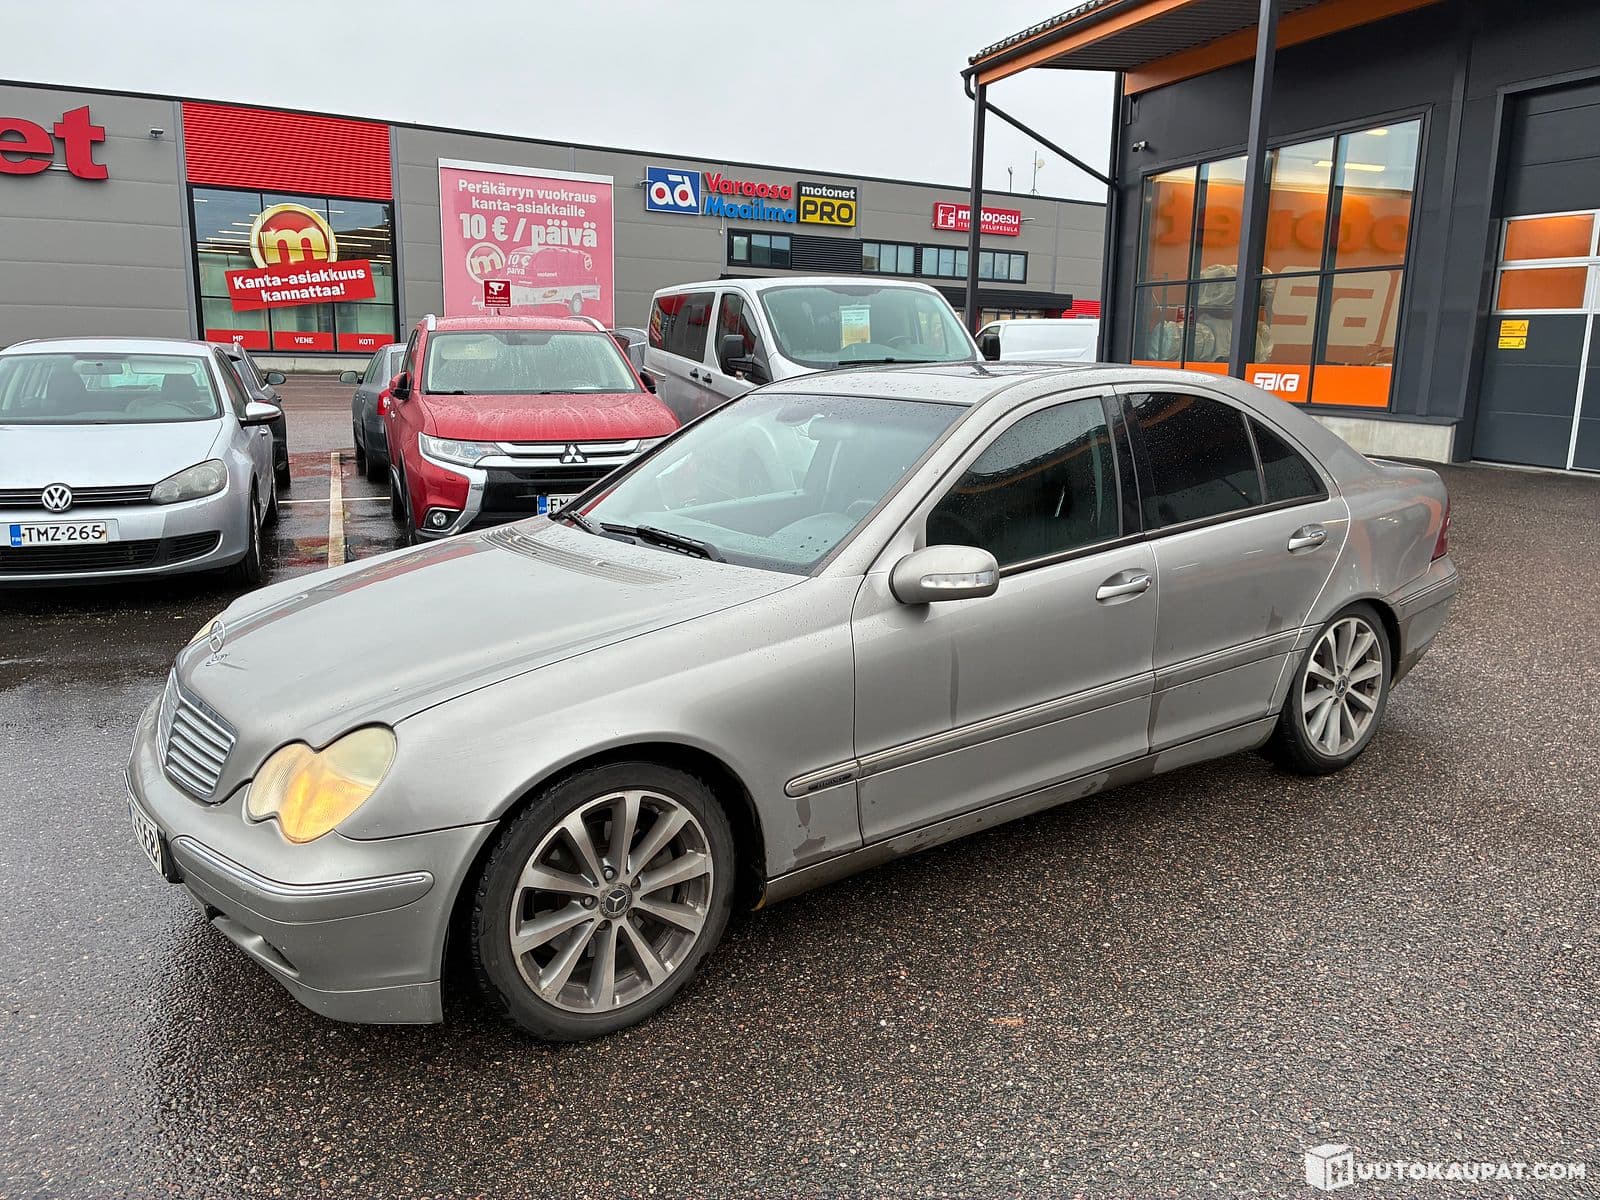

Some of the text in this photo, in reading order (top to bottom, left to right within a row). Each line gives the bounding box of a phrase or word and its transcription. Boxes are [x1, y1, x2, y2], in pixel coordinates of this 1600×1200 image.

[0, 105, 109, 179] et
[458, 178, 597, 204] Peräkärryn vuokraus
[705, 171, 793, 200] Varaosa
[801, 185, 856, 199] motonet
[471, 196, 586, 217] kanta-asiakkaille
[704, 195, 797, 223] Maailma
[802, 200, 854, 223] PRO
[958, 209, 1019, 225] mtopesu
[459, 213, 598, 250] 10 € / päivä
[507, 253, 520, 266] 10
[232, 268, 366, 290] Kanta-asiakkuus
[261, 282, 346, 303] kannattaa!
[294, 336, 314, 344] VENE
[358, 338, 375, 346] KOTI
[24, 525, 103, 543] TMZ-265
